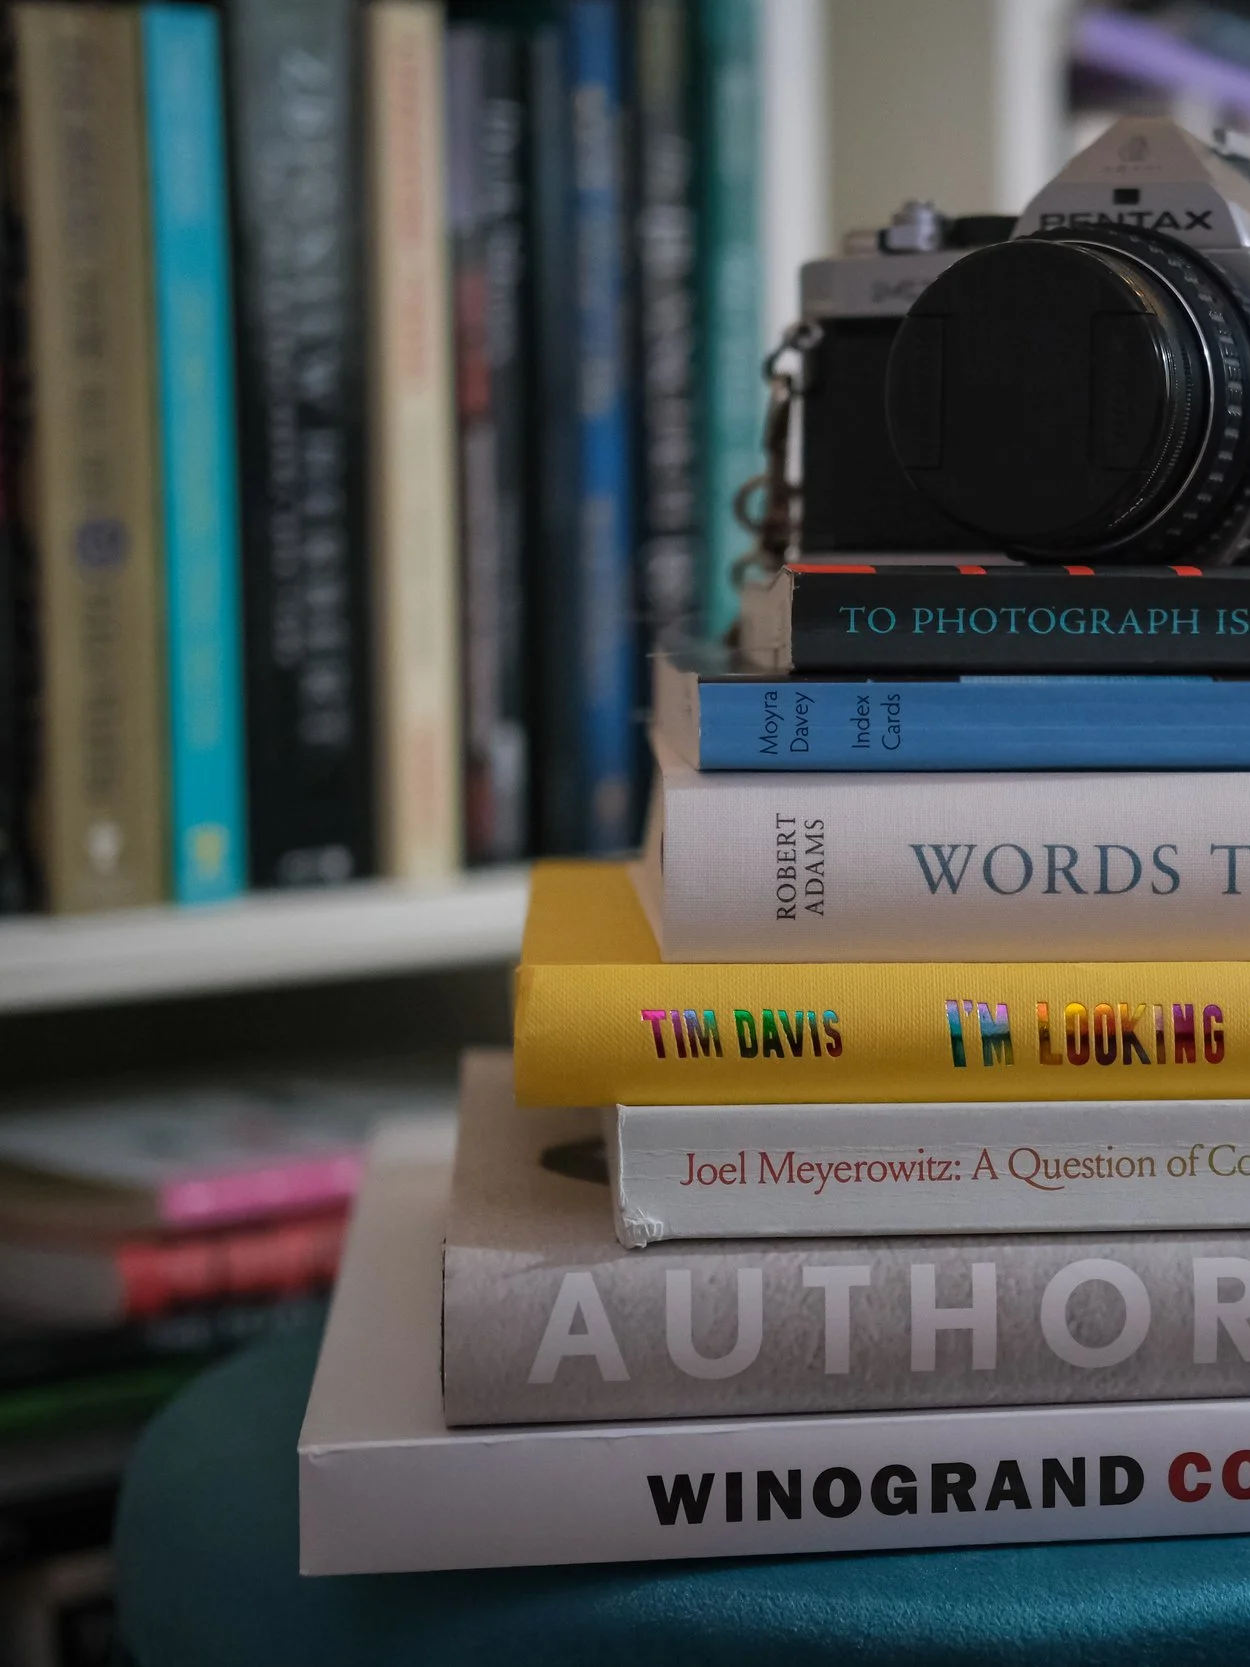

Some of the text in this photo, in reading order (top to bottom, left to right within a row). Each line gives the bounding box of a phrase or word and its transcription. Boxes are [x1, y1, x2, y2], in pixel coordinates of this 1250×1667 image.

[1039, 210, 1213, 231] PENTAX
[840, 607, 896, 633] TO
[913, 608, 1199, 634] PHOTOGRAPH
[1216, 609, 1249, 634] IS
[759, 691, 781, 754] Moyra
[790, 692, 815, 752] Davey
[850, 696, 870, 748] Index
[880, 694, 900, 750] Cards
[777, 814, 796, 920] ROBERT
[805, 820, 824, 916] ADAMS
[910, 844, 1180, 895] WORDS
[641, 1009, 843, 1058] TIM DAVIS
[945, 999, 1015, 1067] I'M
[1037, 1001, 1226, 1066] LOOKING
[680, 1151, 746, 1185] Joel
[758, 1148, 960, 1195] Meyerowitz:
[972, 1148, 998, 1180] A
[1008, 1146, 1156, 1190] Question
[1167, 1144, 1204, 1177] of
[647, 1454, 1145, 1525] WINOGRAND
